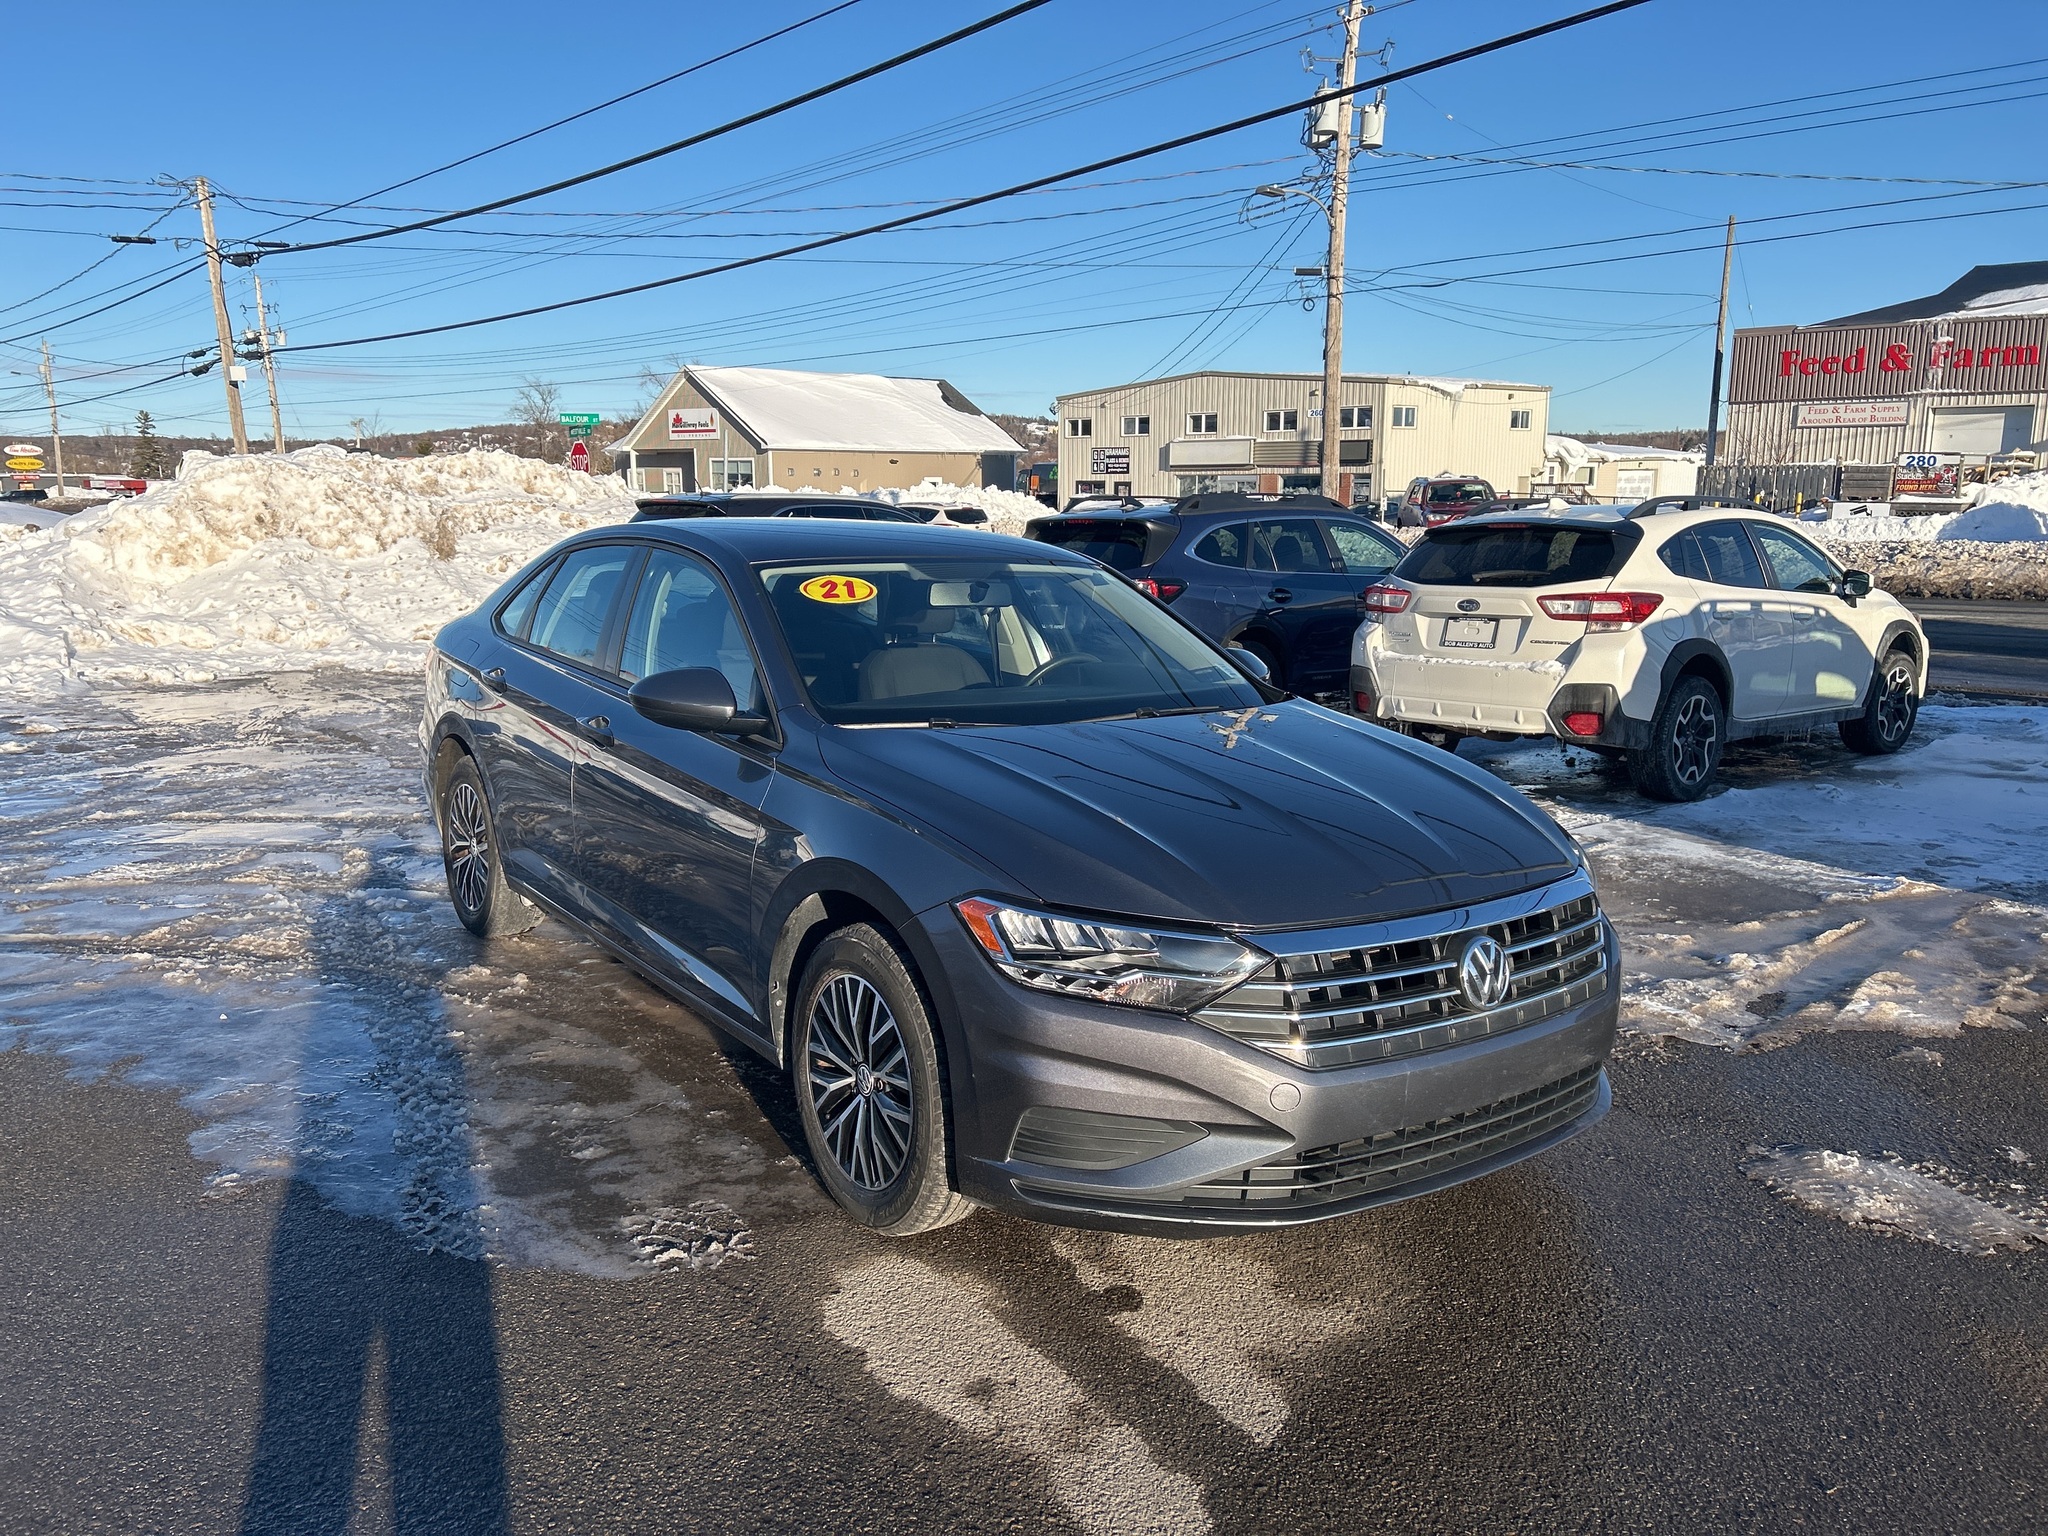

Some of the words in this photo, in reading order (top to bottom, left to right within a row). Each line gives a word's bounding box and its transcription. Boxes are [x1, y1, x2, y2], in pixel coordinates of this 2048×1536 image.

[1779, 346, 1866, 377] Feed
[1880, 342, 1914, 372] &
[1929, 338, 2041, 369] Farm
[1310, 409, 1324, 417] 260
[1807, 406, 1829, 415] FEED
[1831, 405, 1841, 414] &
[1843, 405, 1867, 414] FARM
[1870, 404, 1902, 413] SUPPLY
[561, 415, 589, 423] BALFOUR
[698, 420, 710, 429] Fuels
[1800, 416, 1834, 425] AROUND
[1834, 415, 1857, 424] REAR
[1869, 414, 1907, 423] BUILDING
[572, 454, 588, 470] STOP
[1906, 455, 1937, 467] 280
[819, 579, 856, 599] 21
